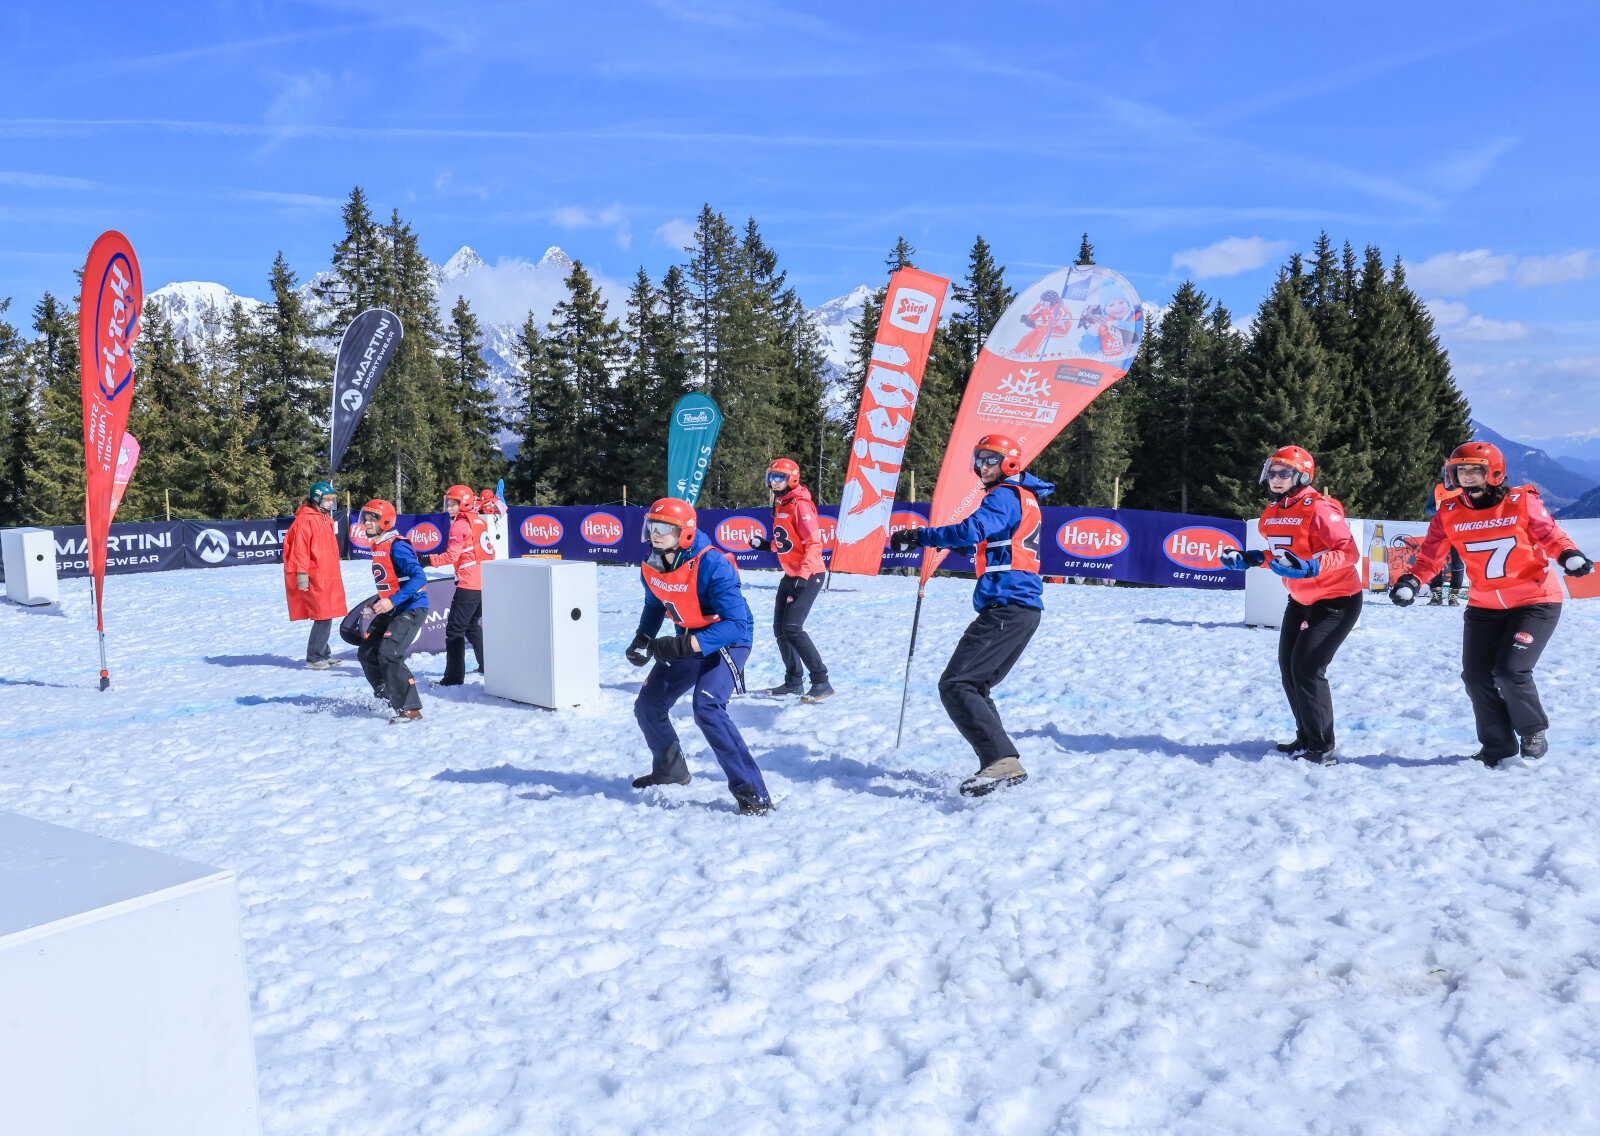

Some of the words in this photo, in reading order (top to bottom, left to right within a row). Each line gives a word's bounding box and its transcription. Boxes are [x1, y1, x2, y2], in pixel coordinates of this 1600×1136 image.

[897, 297, 929, 315] Stiegl
[351, 317, 391, 386] MARTINI
[362, 331, 395, 389] SPORTSWEAR
[981, 392, 1061, 409] SCHISCHULE
[984, 402, 1034, 417] Filzmoos
[835, 342, 919, 546] Stiegl
[685, 445, 712, 508] ZMOOS
[1303, 497, 1314, 506] 5
[1445, 502, 1456, 511] 7
[1510, 493, 1521, 502] 7
[525, 522, 560, 540] Hervis
[584, 520, 621, 539] Hervis
[1453, 515, 1518, 533] YUKIGASSEN
[411, 529, 439, 545] Hervis
[720, 525, 762, 544] Hervis
[773, 524, 794, 555] 3
[1022, 520, 1040, 562] 4
[1064, 526, 1122, 550] Hervis
[1267, 535, 1293, 563] 5
[1463, 535, 1518, 580] 7
[56, 555, 160, 570] SPOSWEAR
[688, 560, 695, 570] 1
[372, 563, 391, 592] 2
